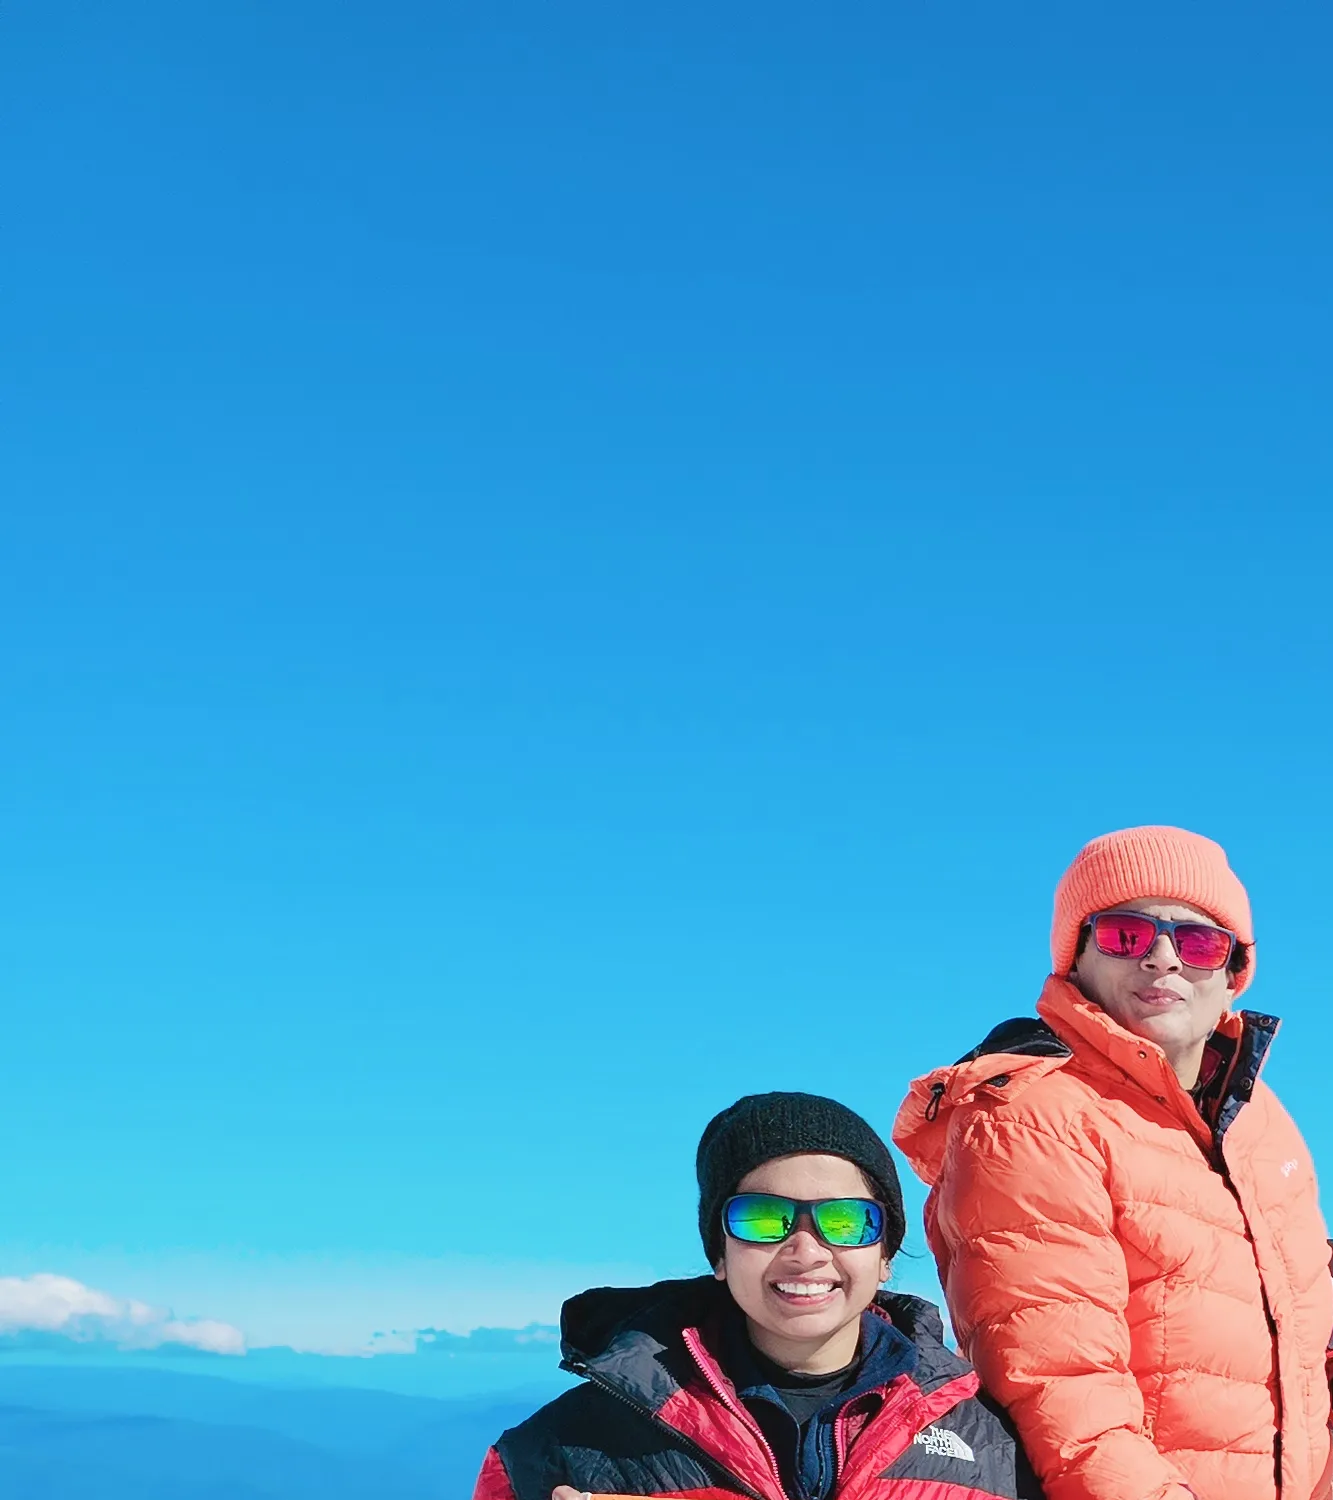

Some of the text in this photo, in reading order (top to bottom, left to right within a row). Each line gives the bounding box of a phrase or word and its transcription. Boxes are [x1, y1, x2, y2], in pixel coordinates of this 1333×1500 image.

[929, 1425, 952, 1439] THE
[914, 1432, 953, 1449] NORTH
[926, 1445, 956, 1457] FACE
